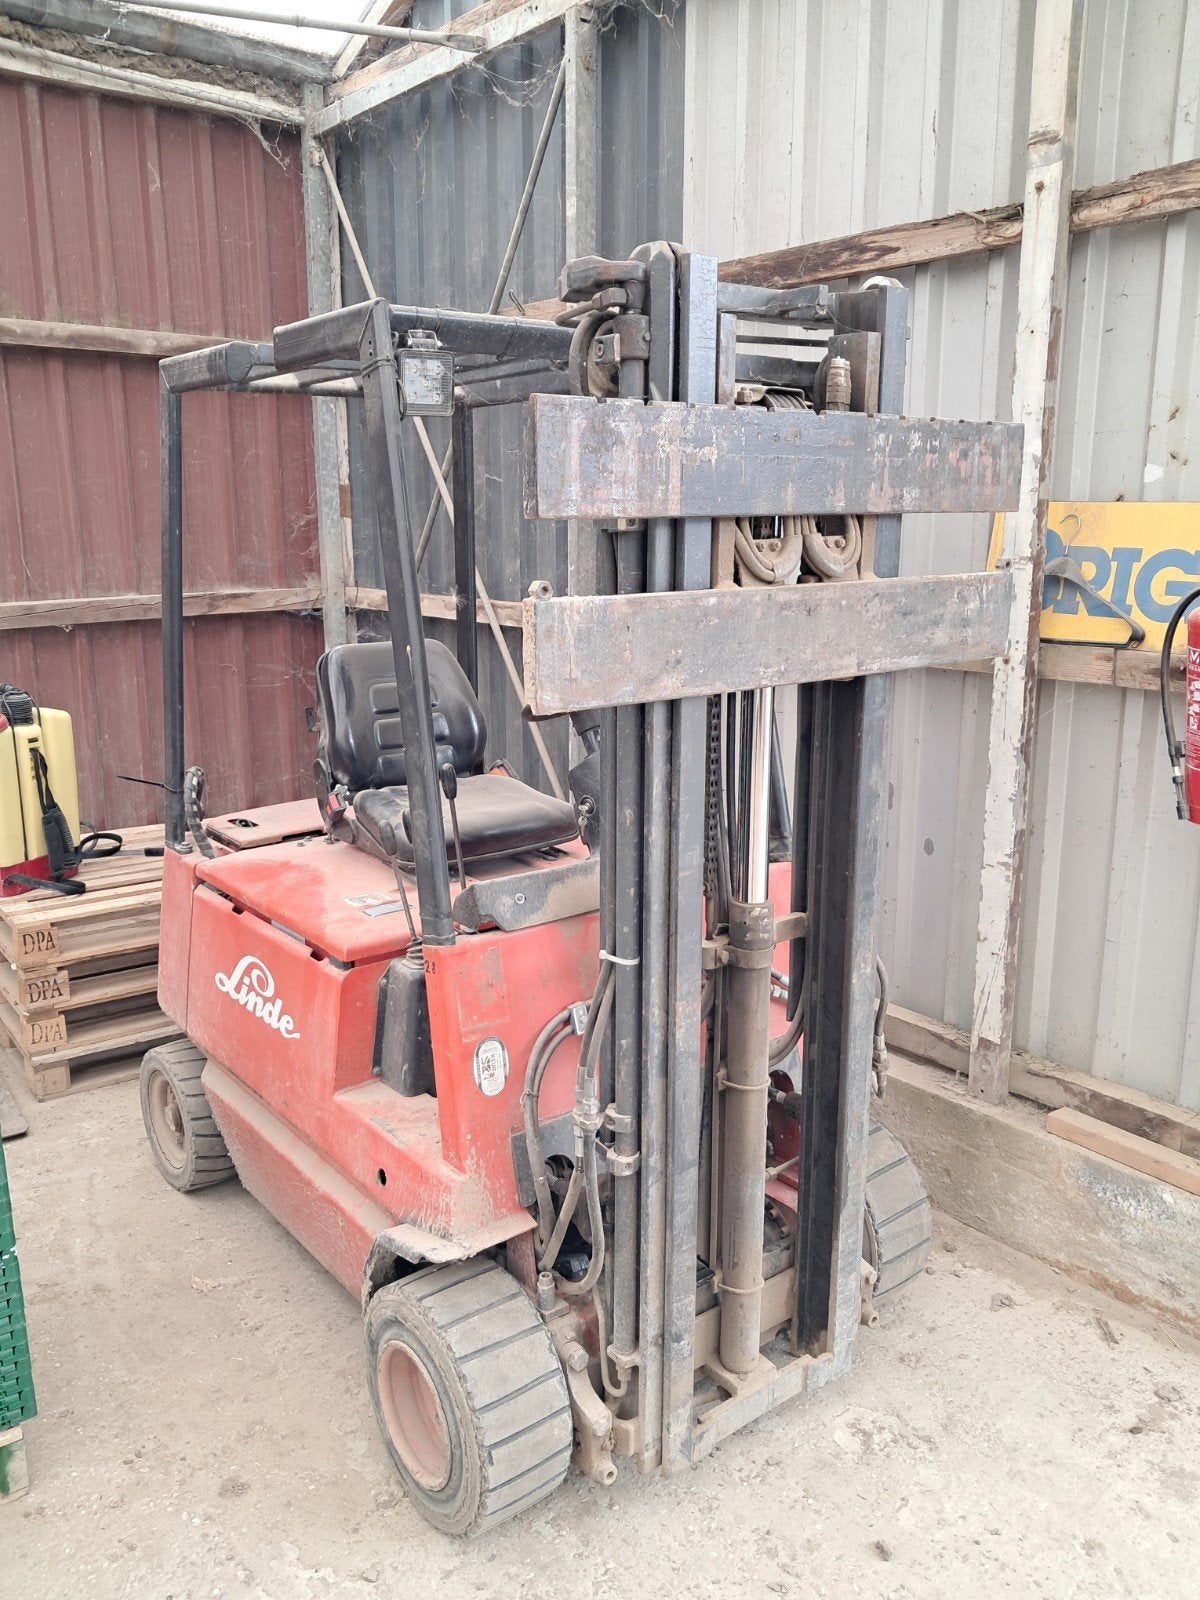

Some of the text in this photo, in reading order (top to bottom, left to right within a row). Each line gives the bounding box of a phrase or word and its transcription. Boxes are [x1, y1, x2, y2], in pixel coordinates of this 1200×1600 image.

[22, 929, 56, 955] DPA
[27, 977, 63, 1004] DPA
[214, 954, 301, 1040] Linde
